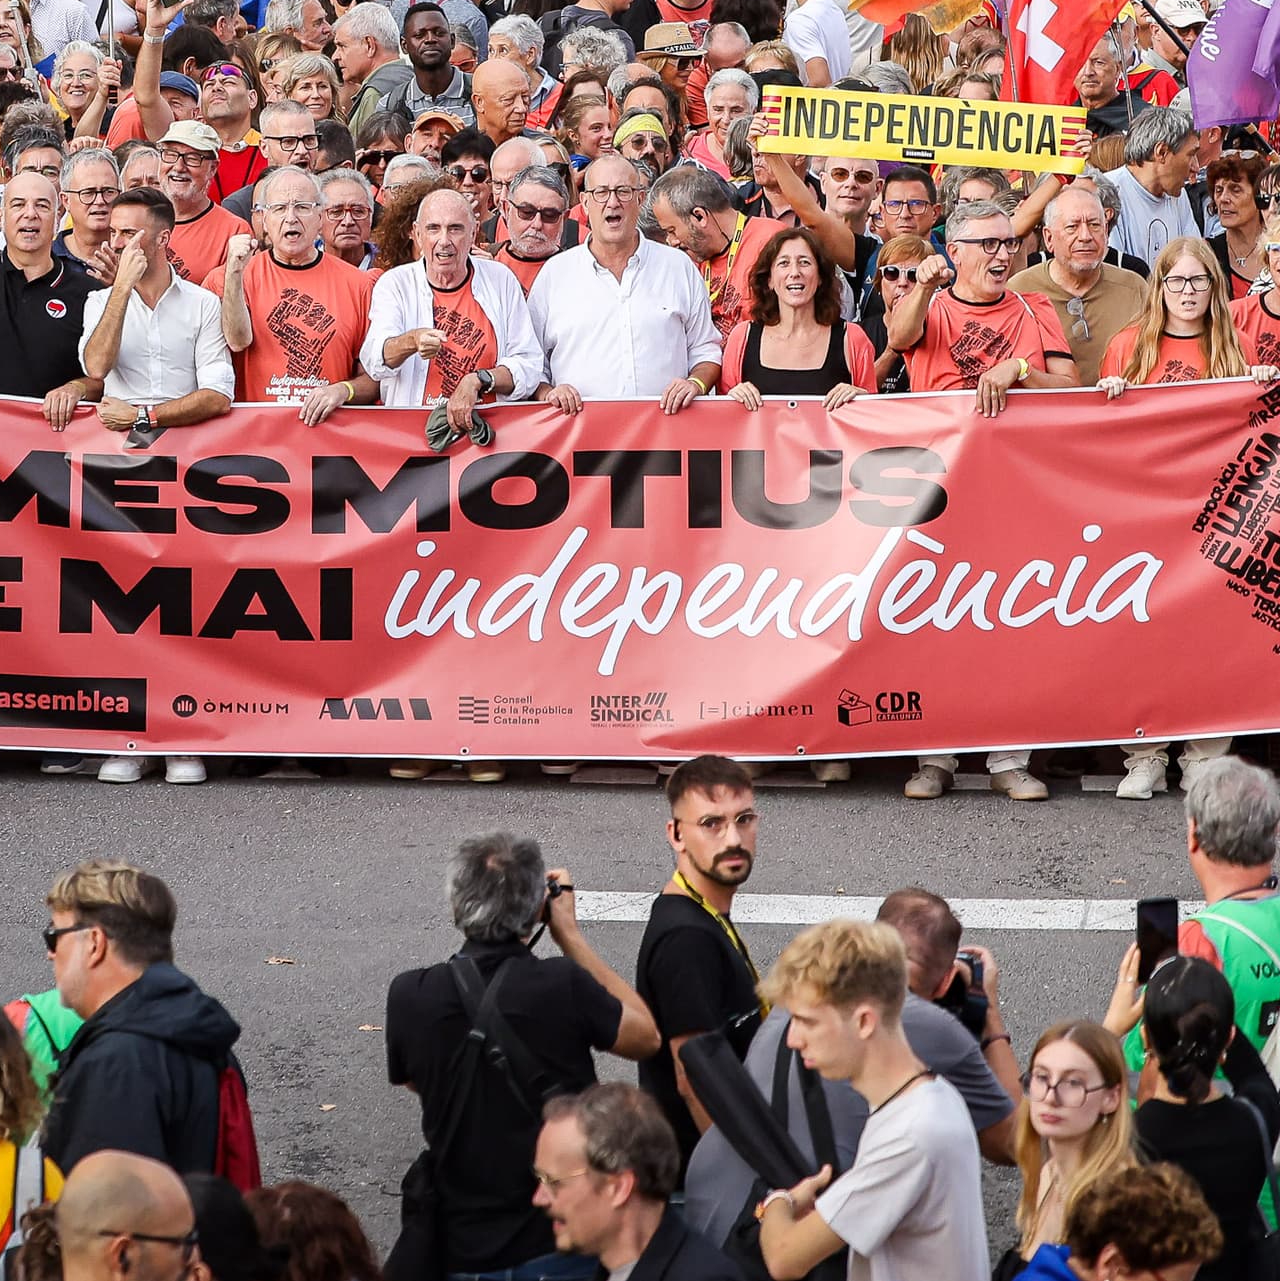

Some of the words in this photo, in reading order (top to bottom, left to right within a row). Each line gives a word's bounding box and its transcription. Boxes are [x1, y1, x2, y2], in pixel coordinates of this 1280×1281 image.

[782, 97, 1057, 157] INDEPENDÈNCIA
[311, 447, 948, 533] MOTIUS
[59, 557, 354, 642] MAI
[384, 525, 1161, 676] independència
[203, 693, 290, 715] ÒMNIUM
[493, 695, 533, 705] Consell
[590, 695, 642, 709] INTER
[875, 691, 922, 714] CDR
[493, 706, 506, 715] de
[508, 706, 519, 715] la
[521, 705, 574, 717] República
[590, 709, 675, 722] SINDICAL
[876, 713, 923, 722] CATALUNYA
[493, 716, 540, 726] Catalana
